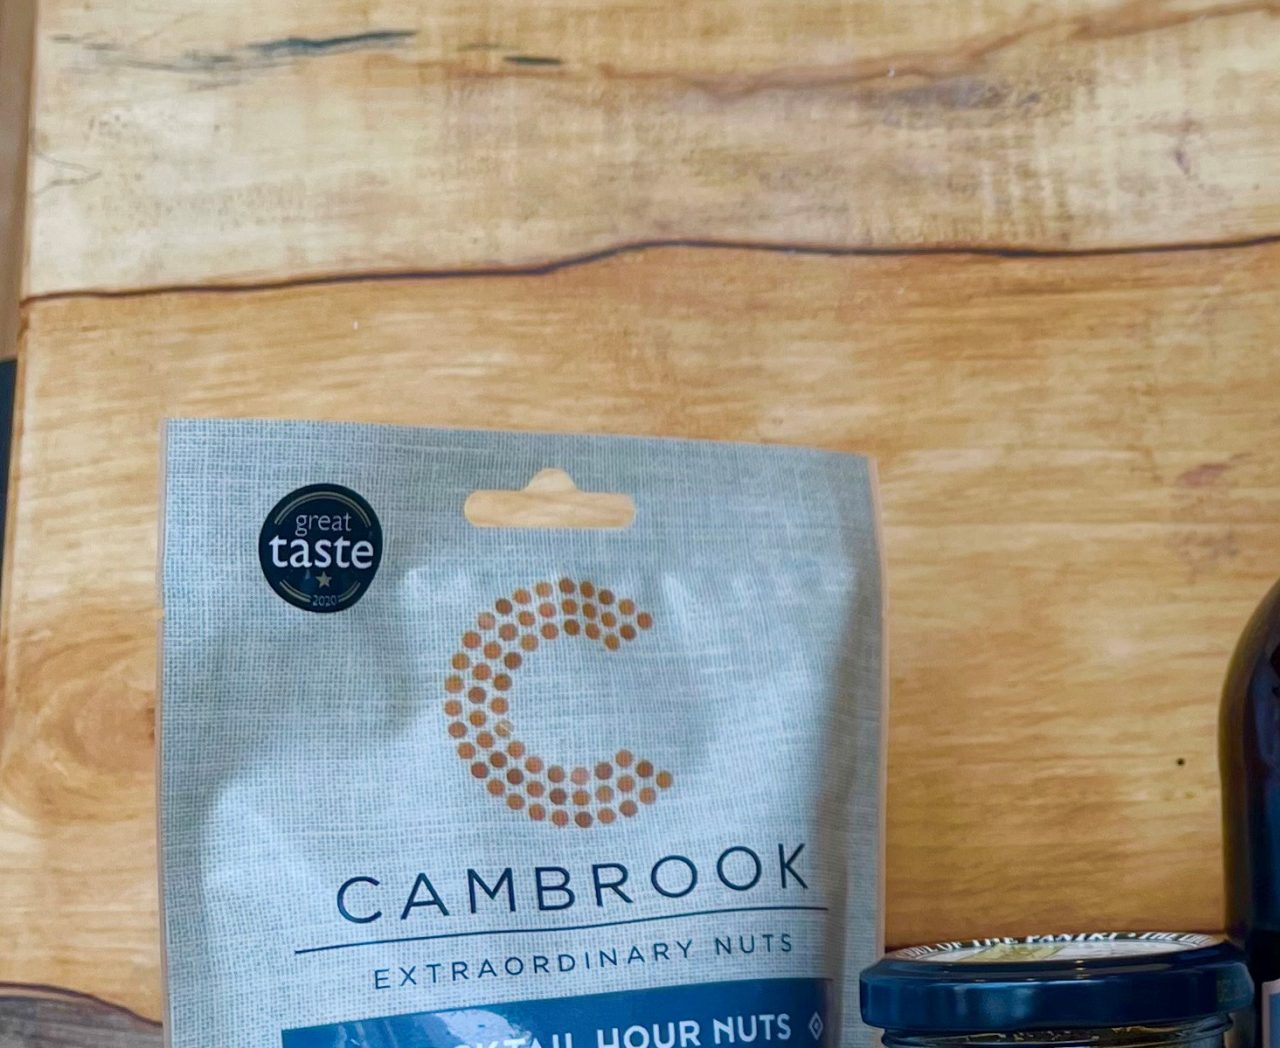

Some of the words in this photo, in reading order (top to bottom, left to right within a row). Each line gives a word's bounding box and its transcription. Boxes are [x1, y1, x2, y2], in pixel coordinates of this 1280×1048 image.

[294, 512, 352, 537] great
[269, 535, 374, 569] taste
[336, 842, 809, 924] CAMBROOK
[374, 939, 695, 990] EXTRAORDINARY
[715, 932, 793, 956] NUTS
[713, 1013, 792, 1044] NUTS
